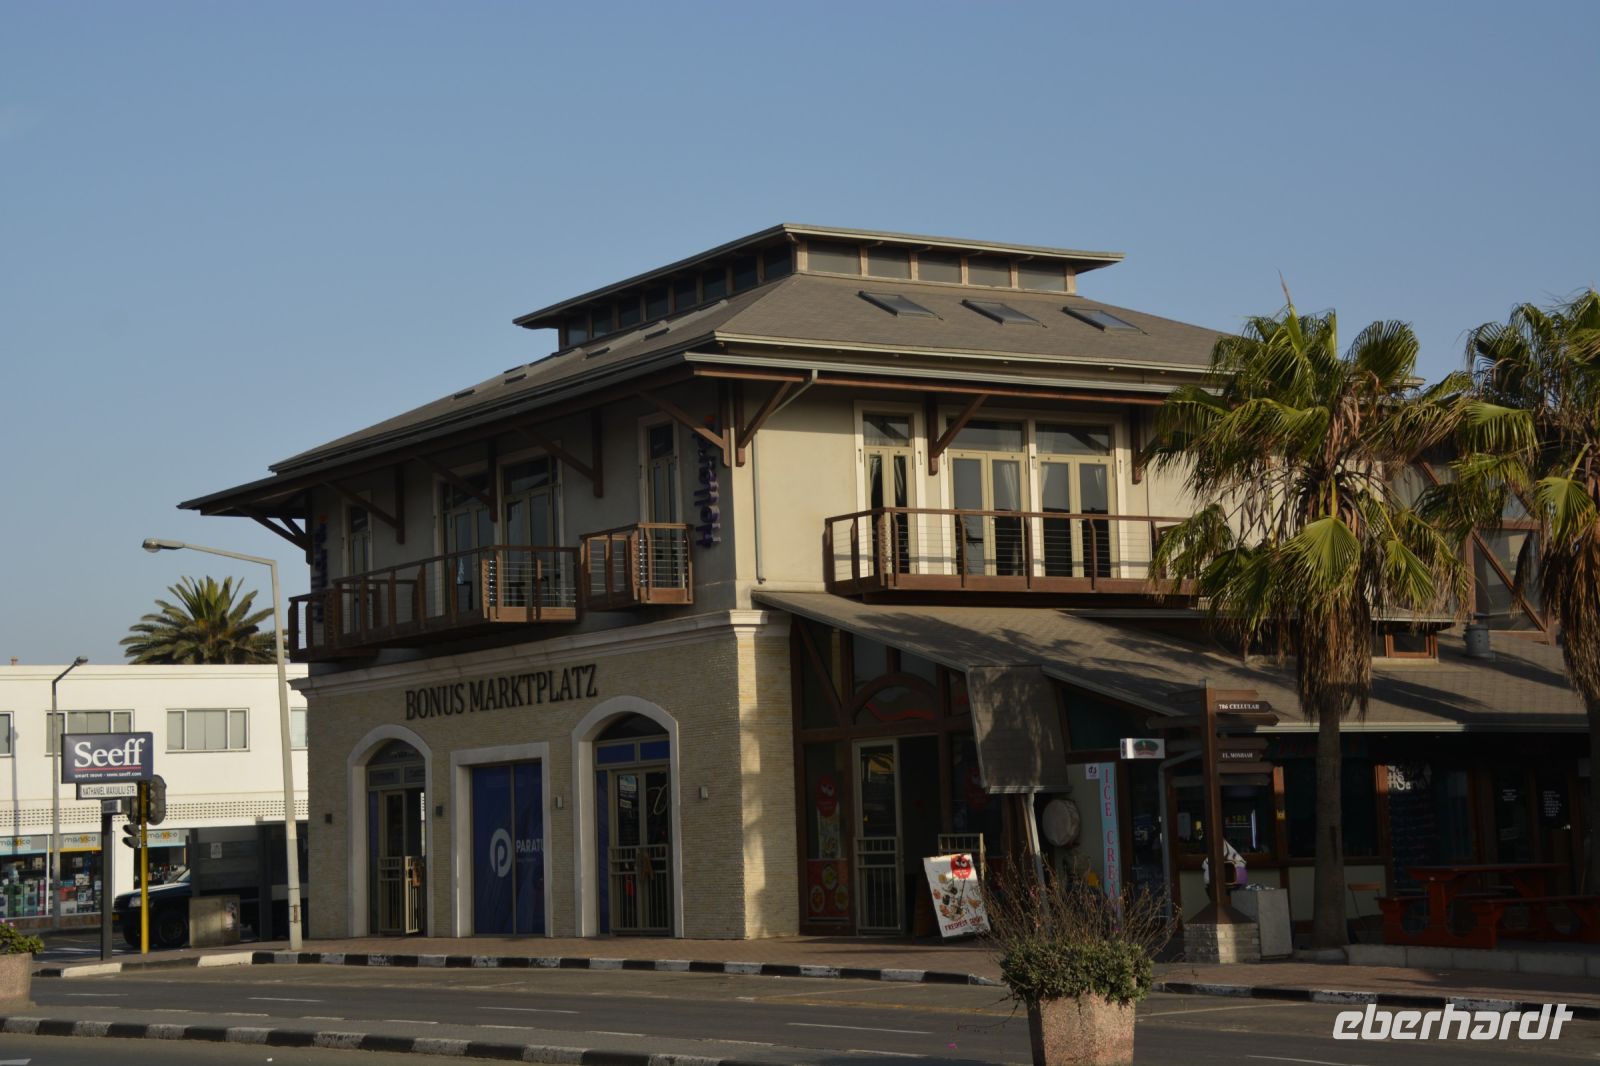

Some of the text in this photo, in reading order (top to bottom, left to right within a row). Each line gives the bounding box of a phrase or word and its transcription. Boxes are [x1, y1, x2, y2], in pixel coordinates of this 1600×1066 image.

[405, 664, 598, 721] BONUS MARKTPLATZ
[74, 738, 146, 768] Seeff
[1103, 767, 1113, 817] ICE
[1106, 830, 1117, 905] CREA
